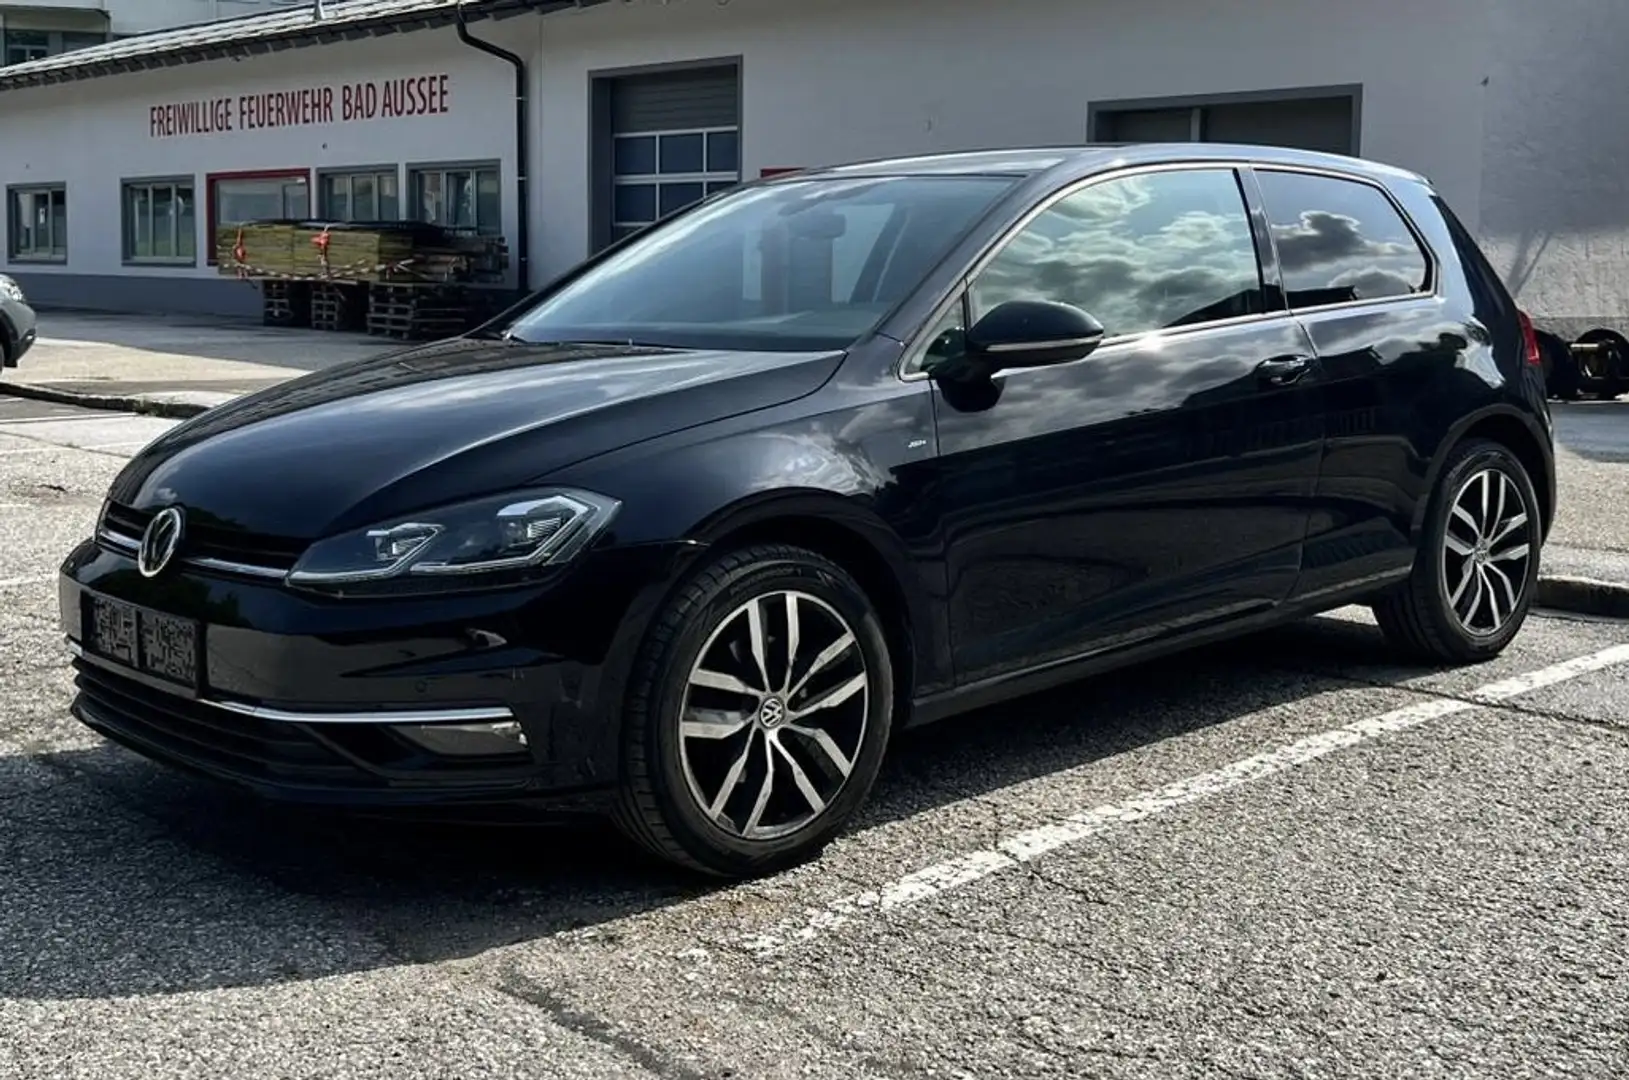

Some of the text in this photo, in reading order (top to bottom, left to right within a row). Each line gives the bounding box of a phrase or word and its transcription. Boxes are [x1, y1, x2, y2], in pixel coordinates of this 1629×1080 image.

[150, 74, 449, 137] FREIWILLIGE FEUERWEHR BAD AUSSEE
